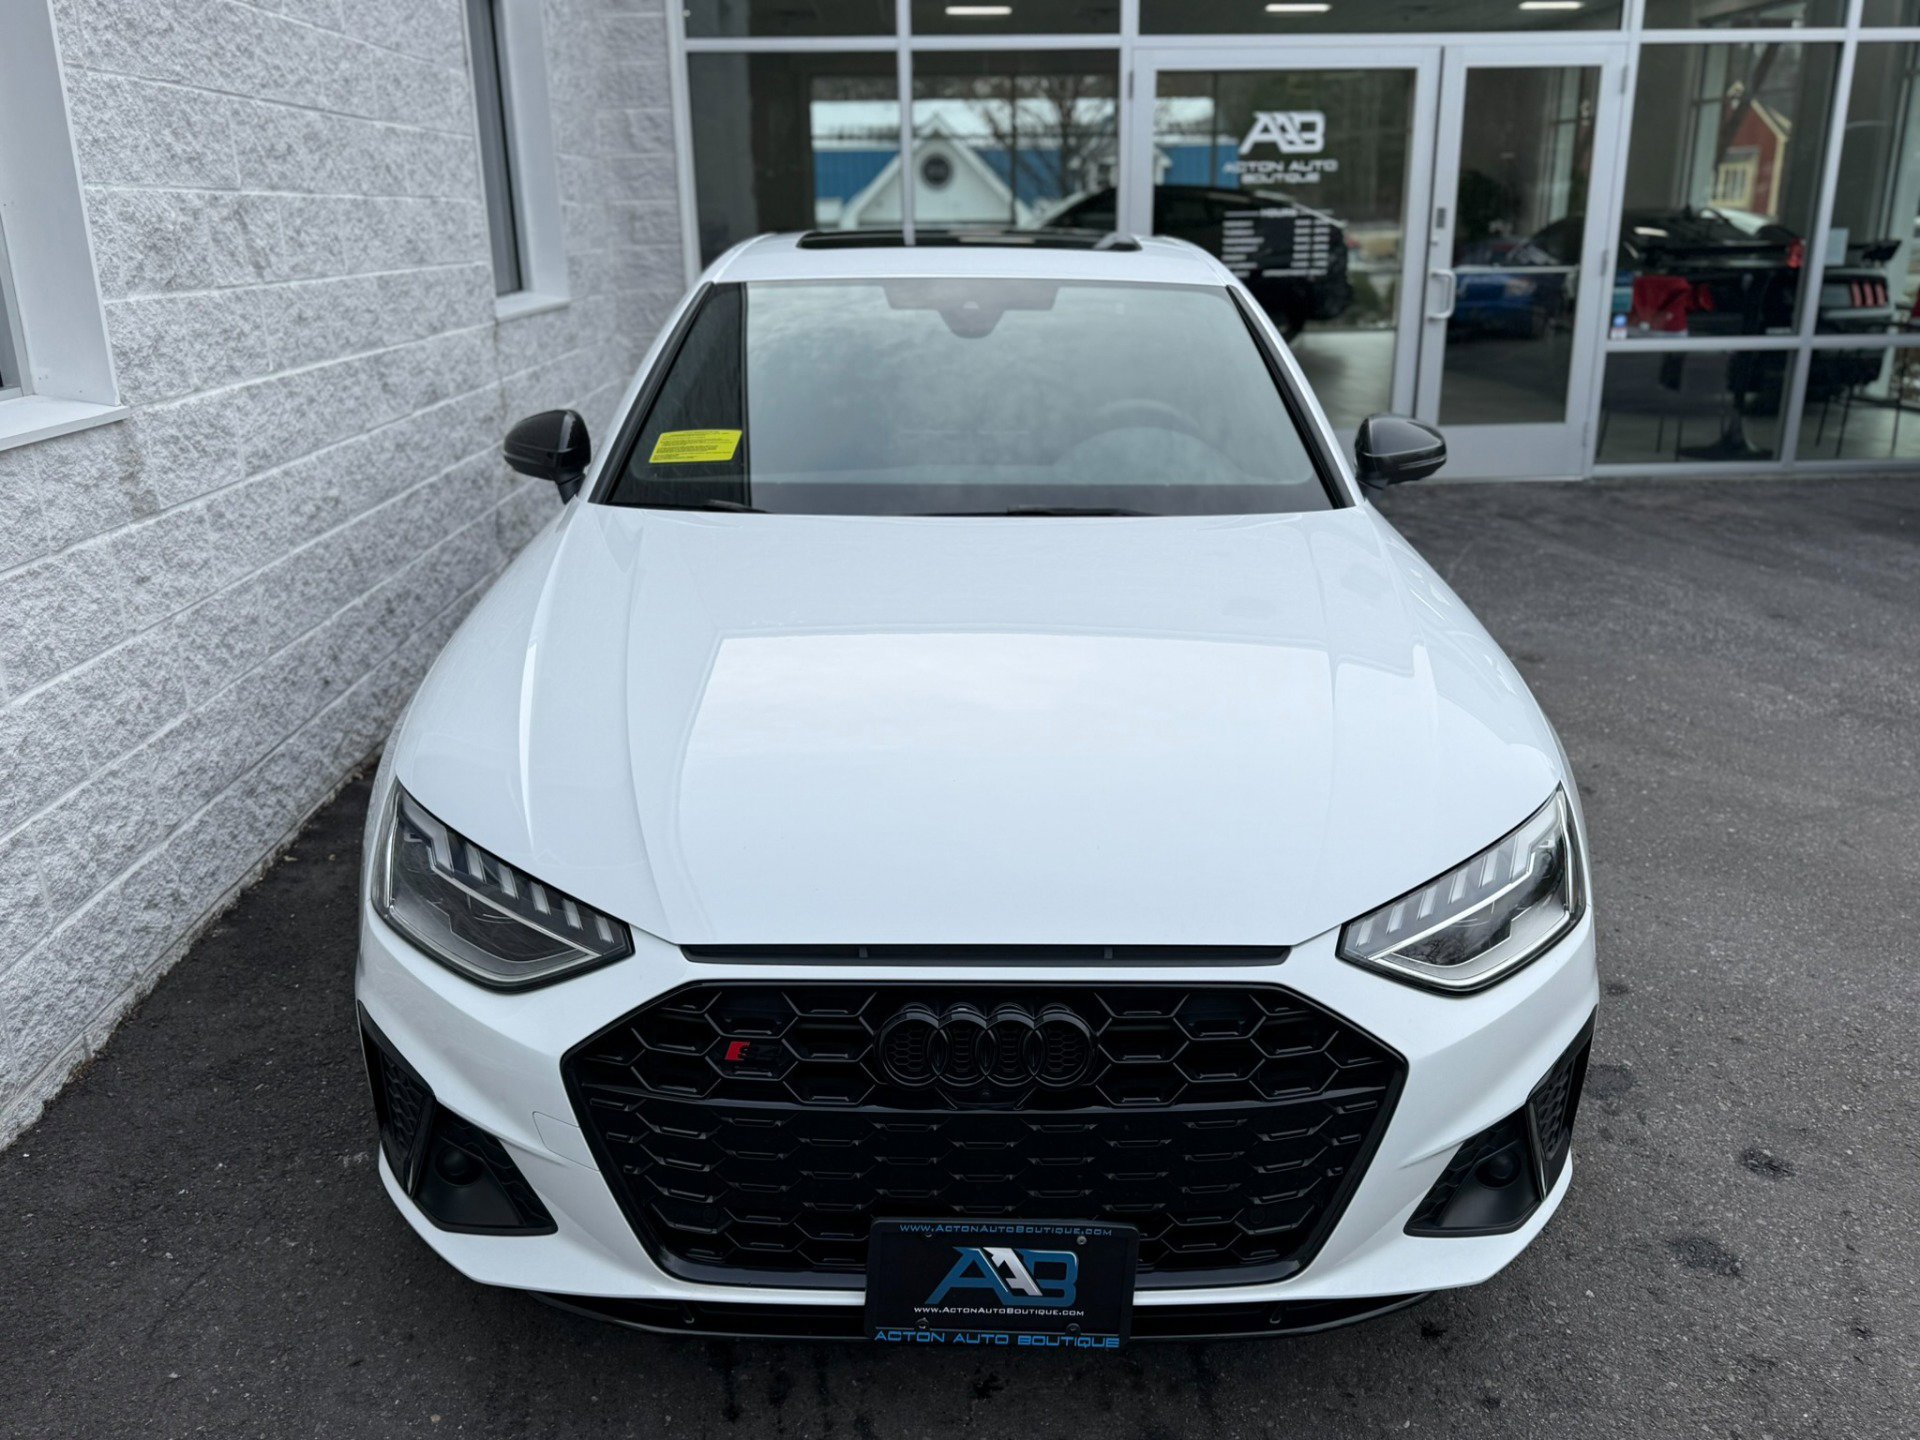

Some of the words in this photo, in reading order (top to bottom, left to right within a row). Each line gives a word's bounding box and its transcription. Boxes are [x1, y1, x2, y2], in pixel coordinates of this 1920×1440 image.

[1288, 159, 1339, 172] AUTO
[874, 1330, 945, 1343] ACTON
[953, 1333, 1009, 1345] AUTO
[1018, 1335, 1120, 1348] BOUTIQUE
